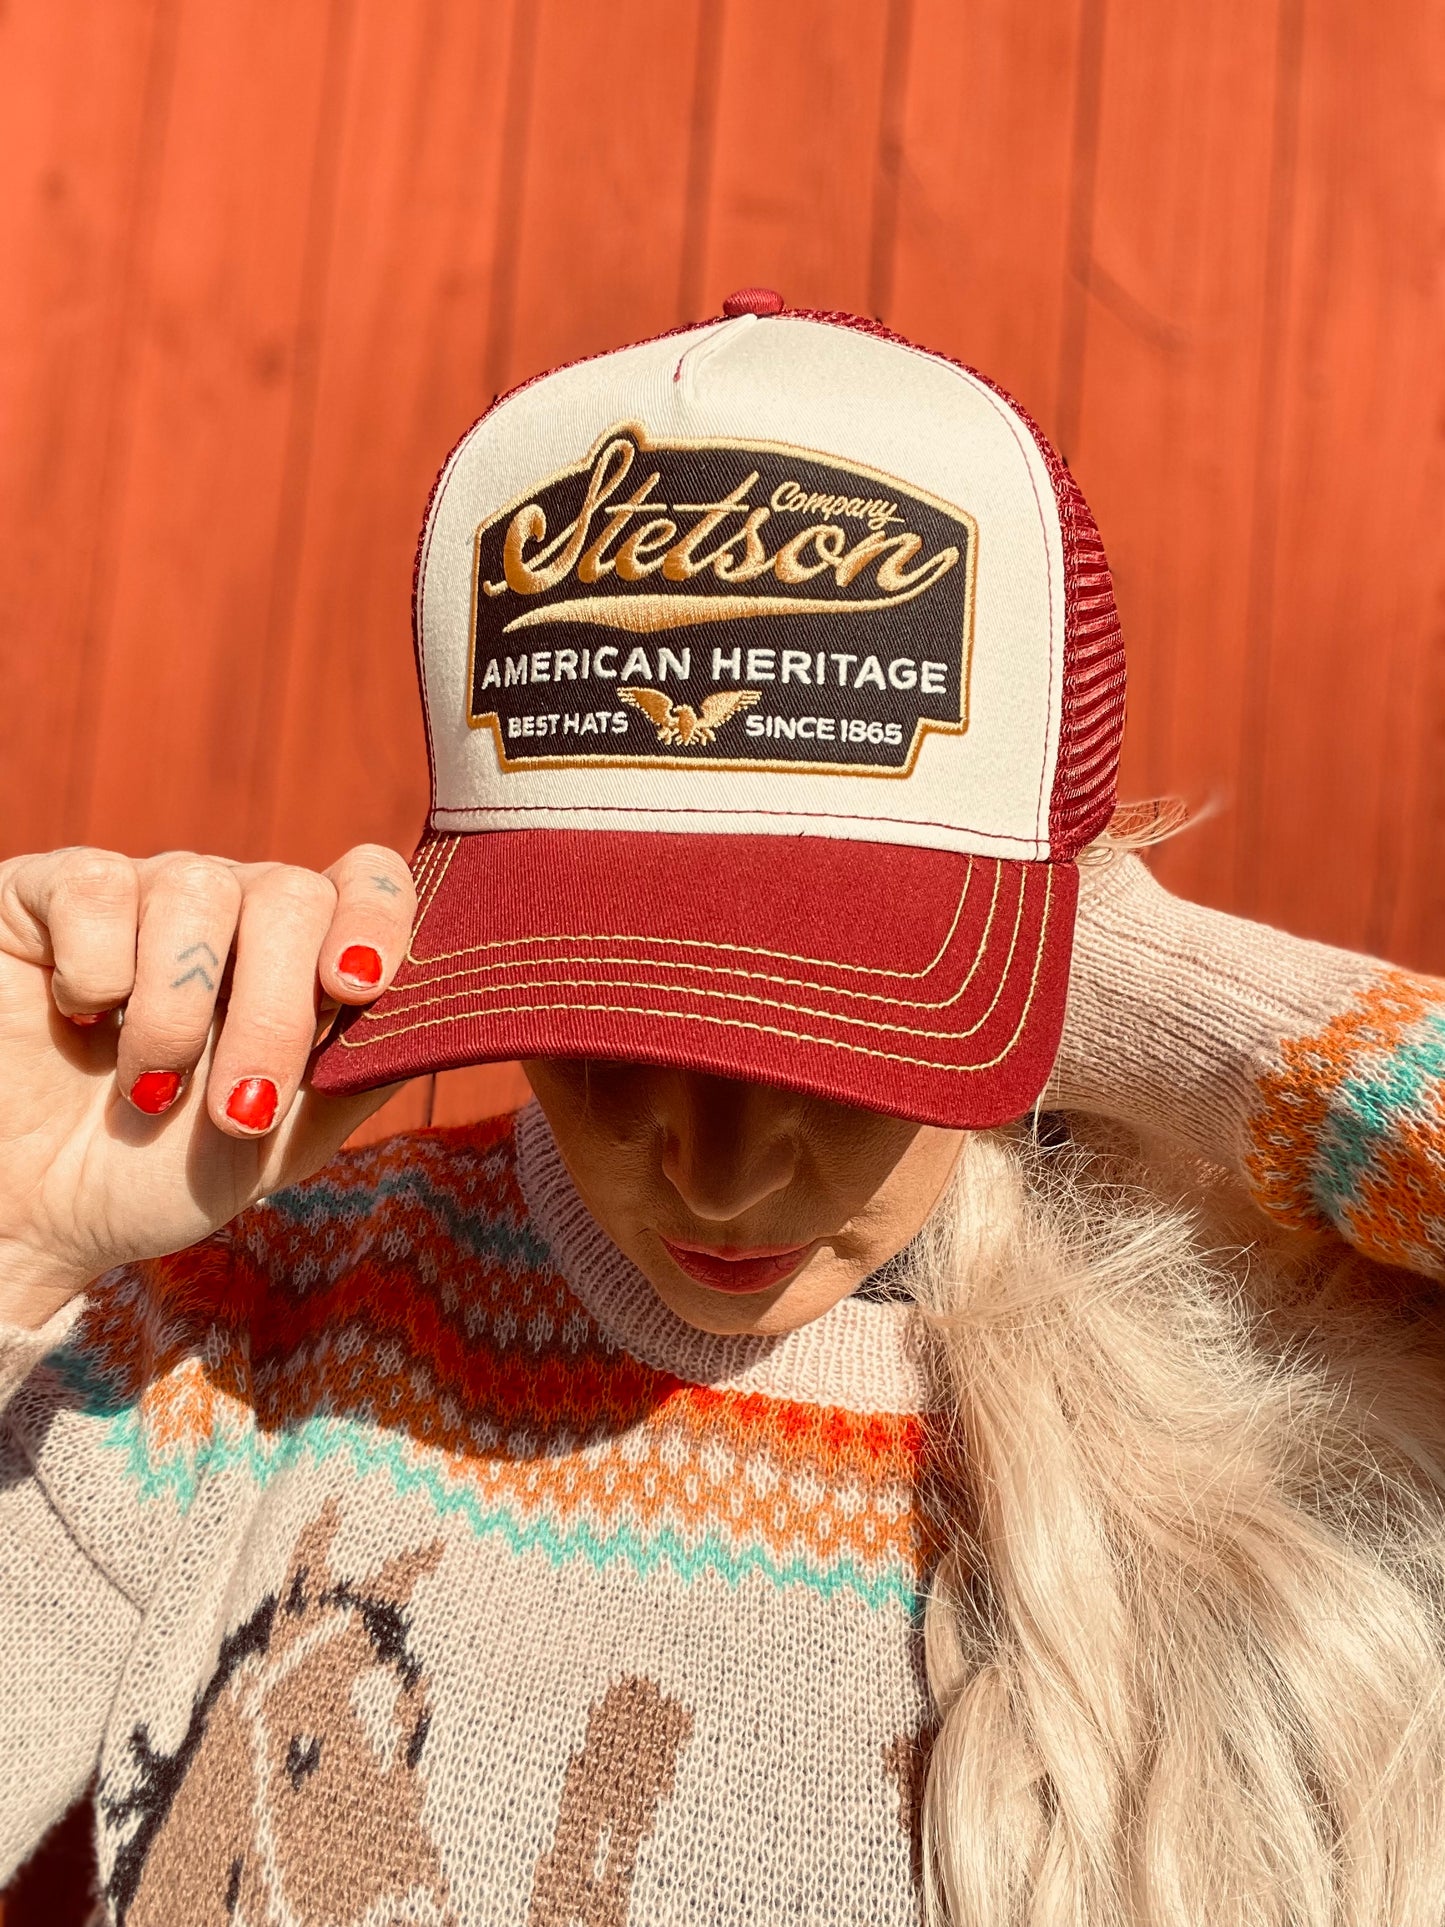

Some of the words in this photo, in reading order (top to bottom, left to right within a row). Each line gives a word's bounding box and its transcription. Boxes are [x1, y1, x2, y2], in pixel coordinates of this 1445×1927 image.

[483, 439, 959, 597] Stetson
[770, 482, 904, 530] Company
[482, 646, 691, 690] AMERICAN
[713, 647, 949, 695] HERITAGE
[507, 713, 562, 738] BEST
[563, 710, 628, 736] HATS
[745, 714, 836, 742] SINCE
[841, 721, 903, 746] 1865
